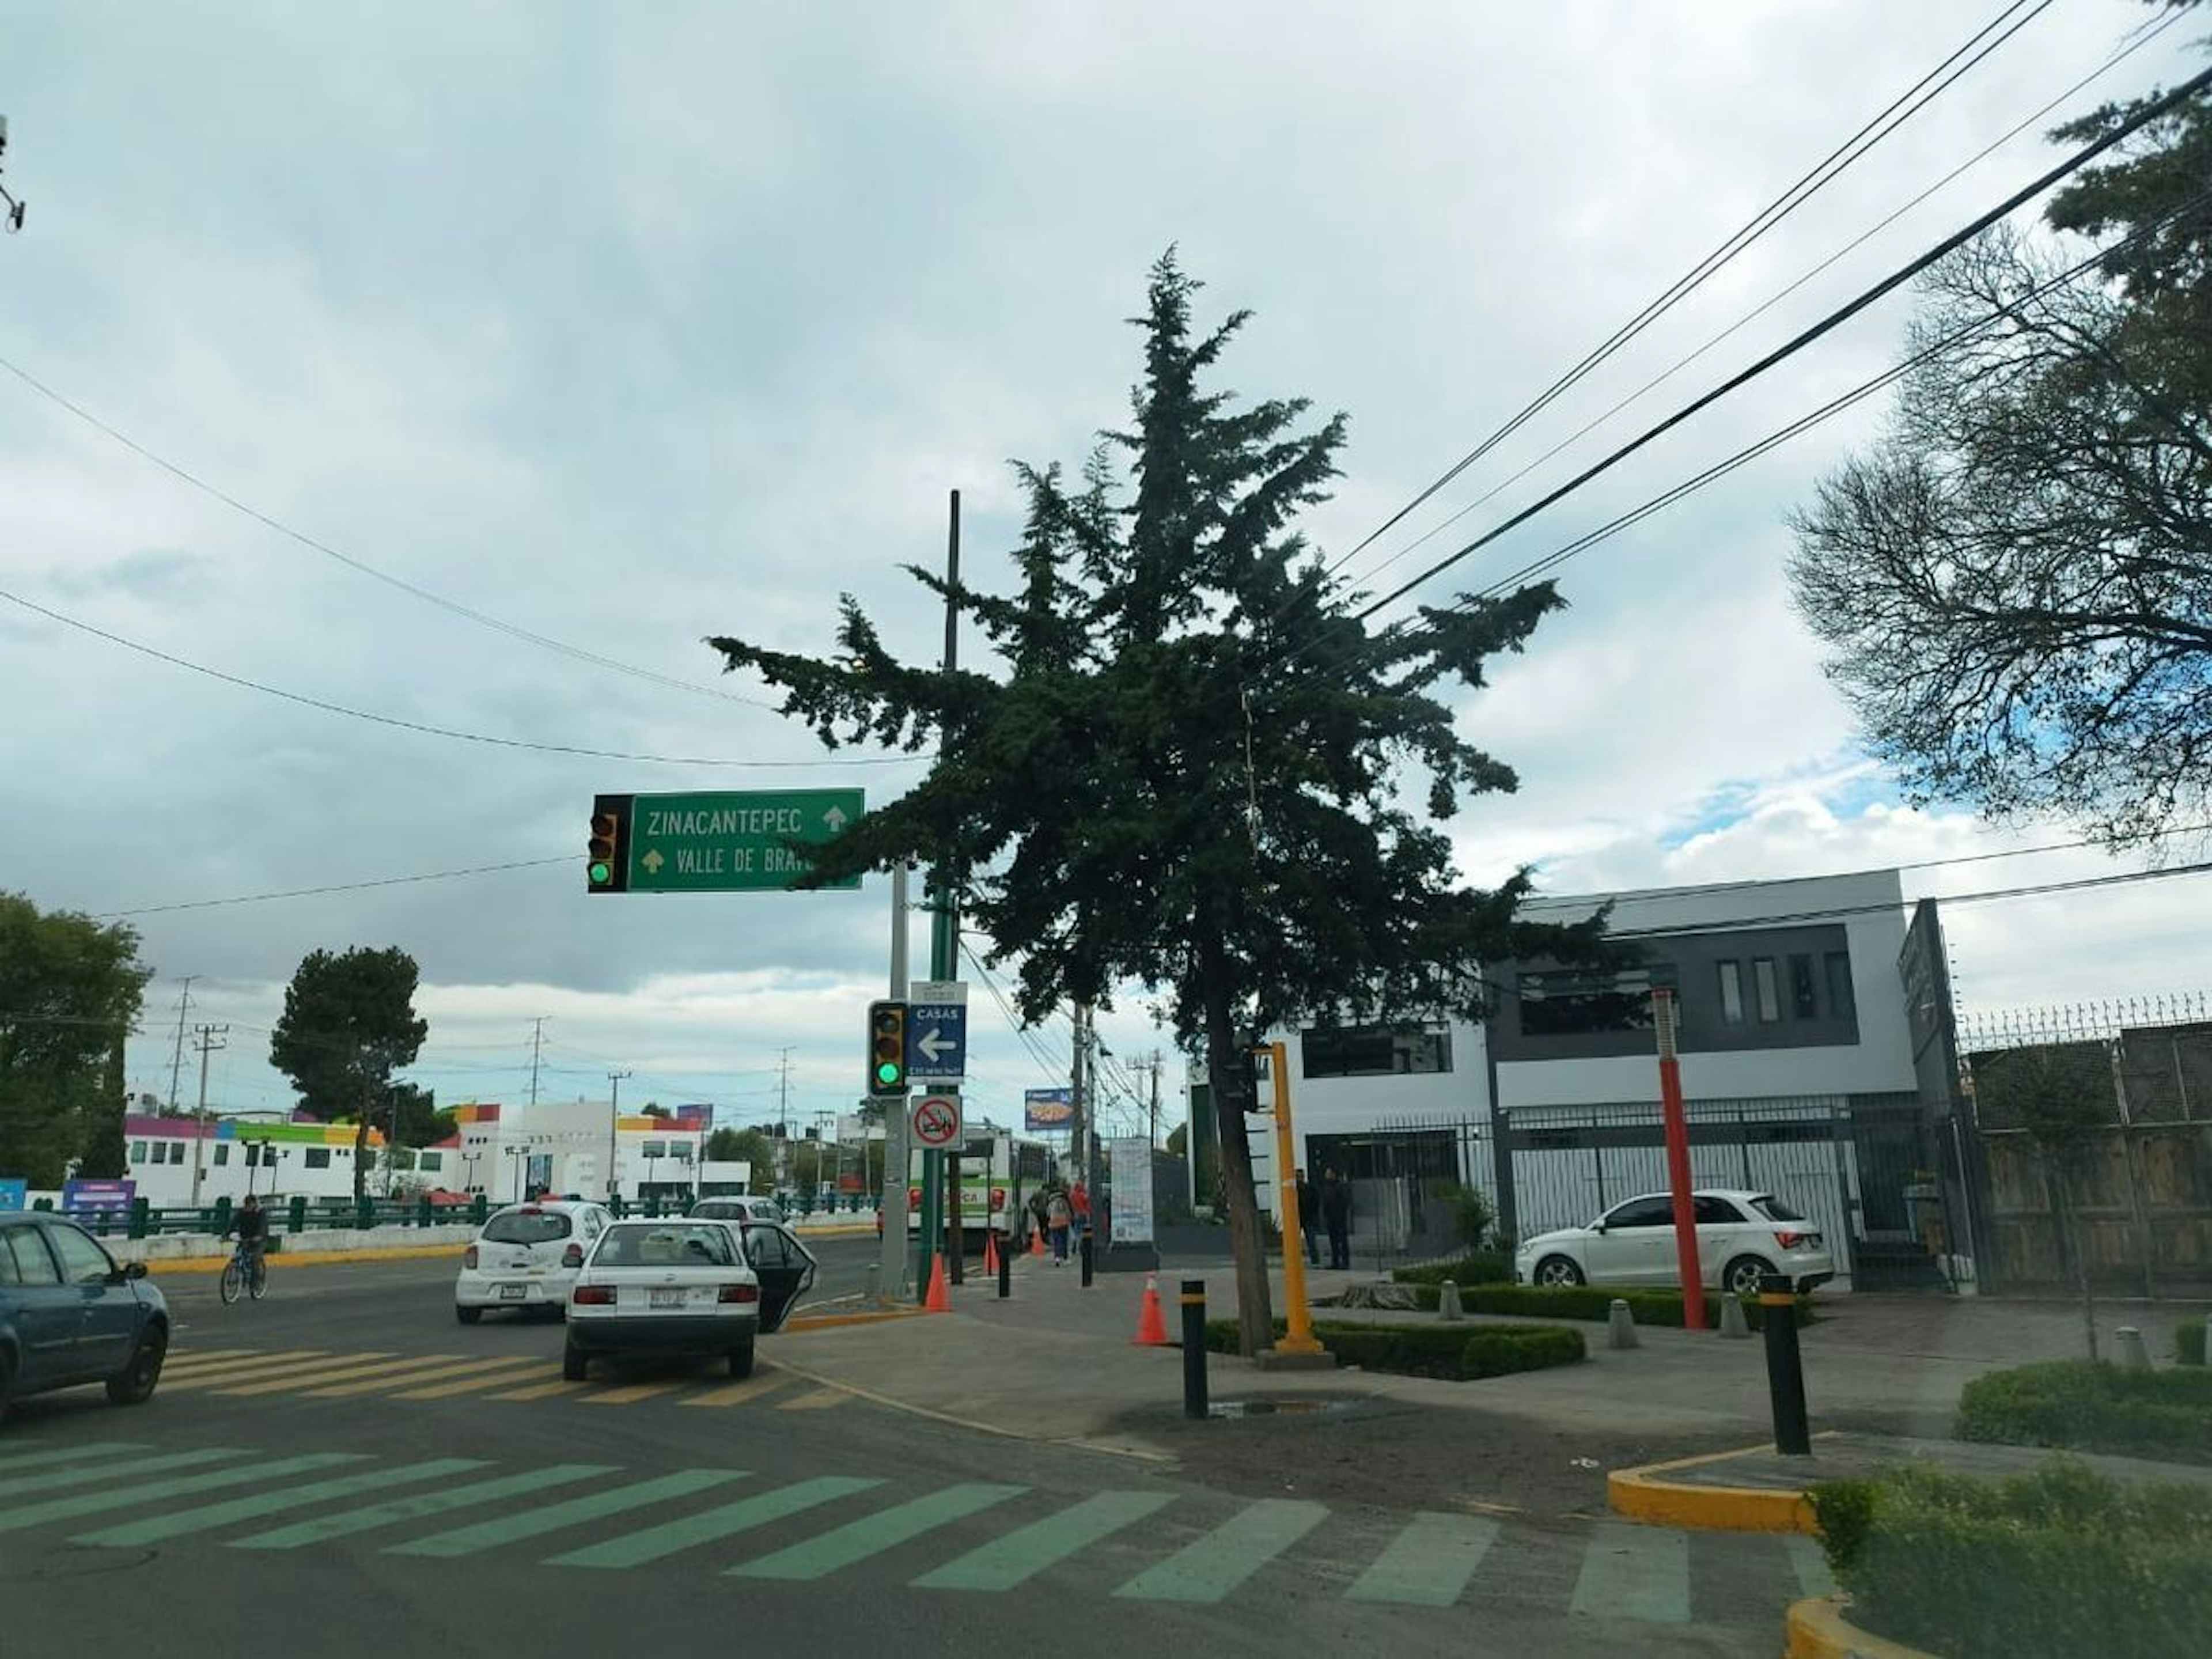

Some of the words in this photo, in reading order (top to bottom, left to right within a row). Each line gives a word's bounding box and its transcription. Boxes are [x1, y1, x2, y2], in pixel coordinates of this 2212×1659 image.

[647, 808, 802, 836] ZINACANTEPEC
[677, 849, 724, 873] VALLE
[734, 848, 754, 873] DE
[916, 1009, 958, 1020] CASAS
